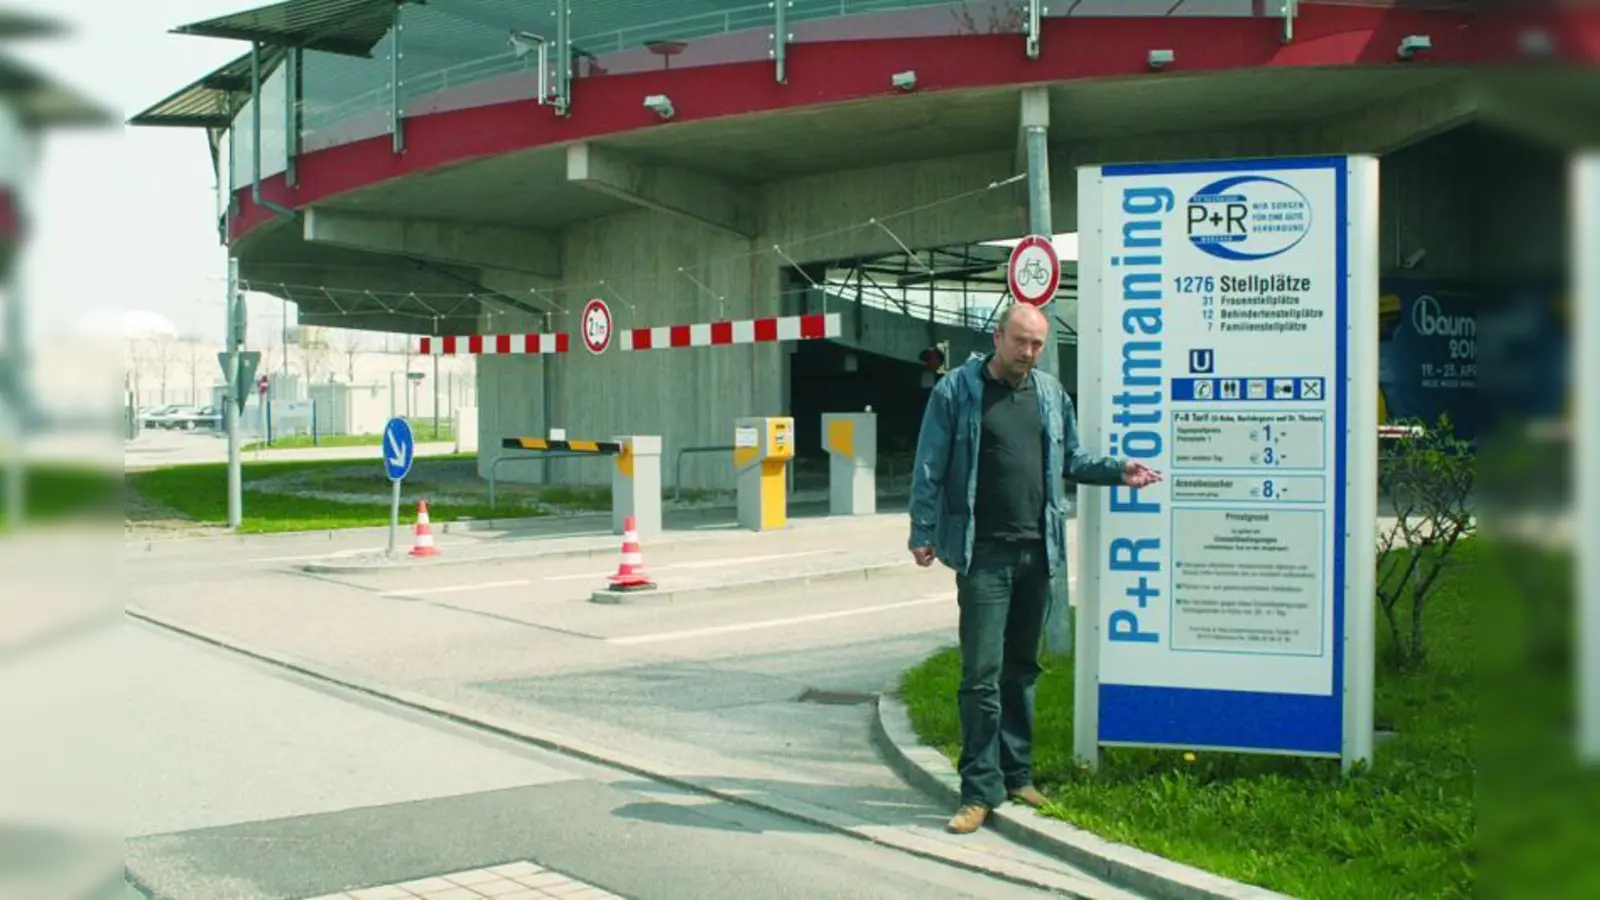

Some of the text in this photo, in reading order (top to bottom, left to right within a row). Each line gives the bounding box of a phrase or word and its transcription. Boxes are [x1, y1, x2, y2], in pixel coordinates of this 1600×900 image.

[1187, 203, 1248, 234] P+R
[1174, 274, 1311, 295] 1276 Stellplätze
[1202, 295, 1300, 306] 31 Frauenstellplätze
[1202, 308, 1324, 319] 12 Behindertenstellplätze
[1207, 321, 1307, 333] 7 Familienstellplätze
[1191, 350, 1212, 372] U
[1108, 185, 1174, 642] P+R Föttmaning
